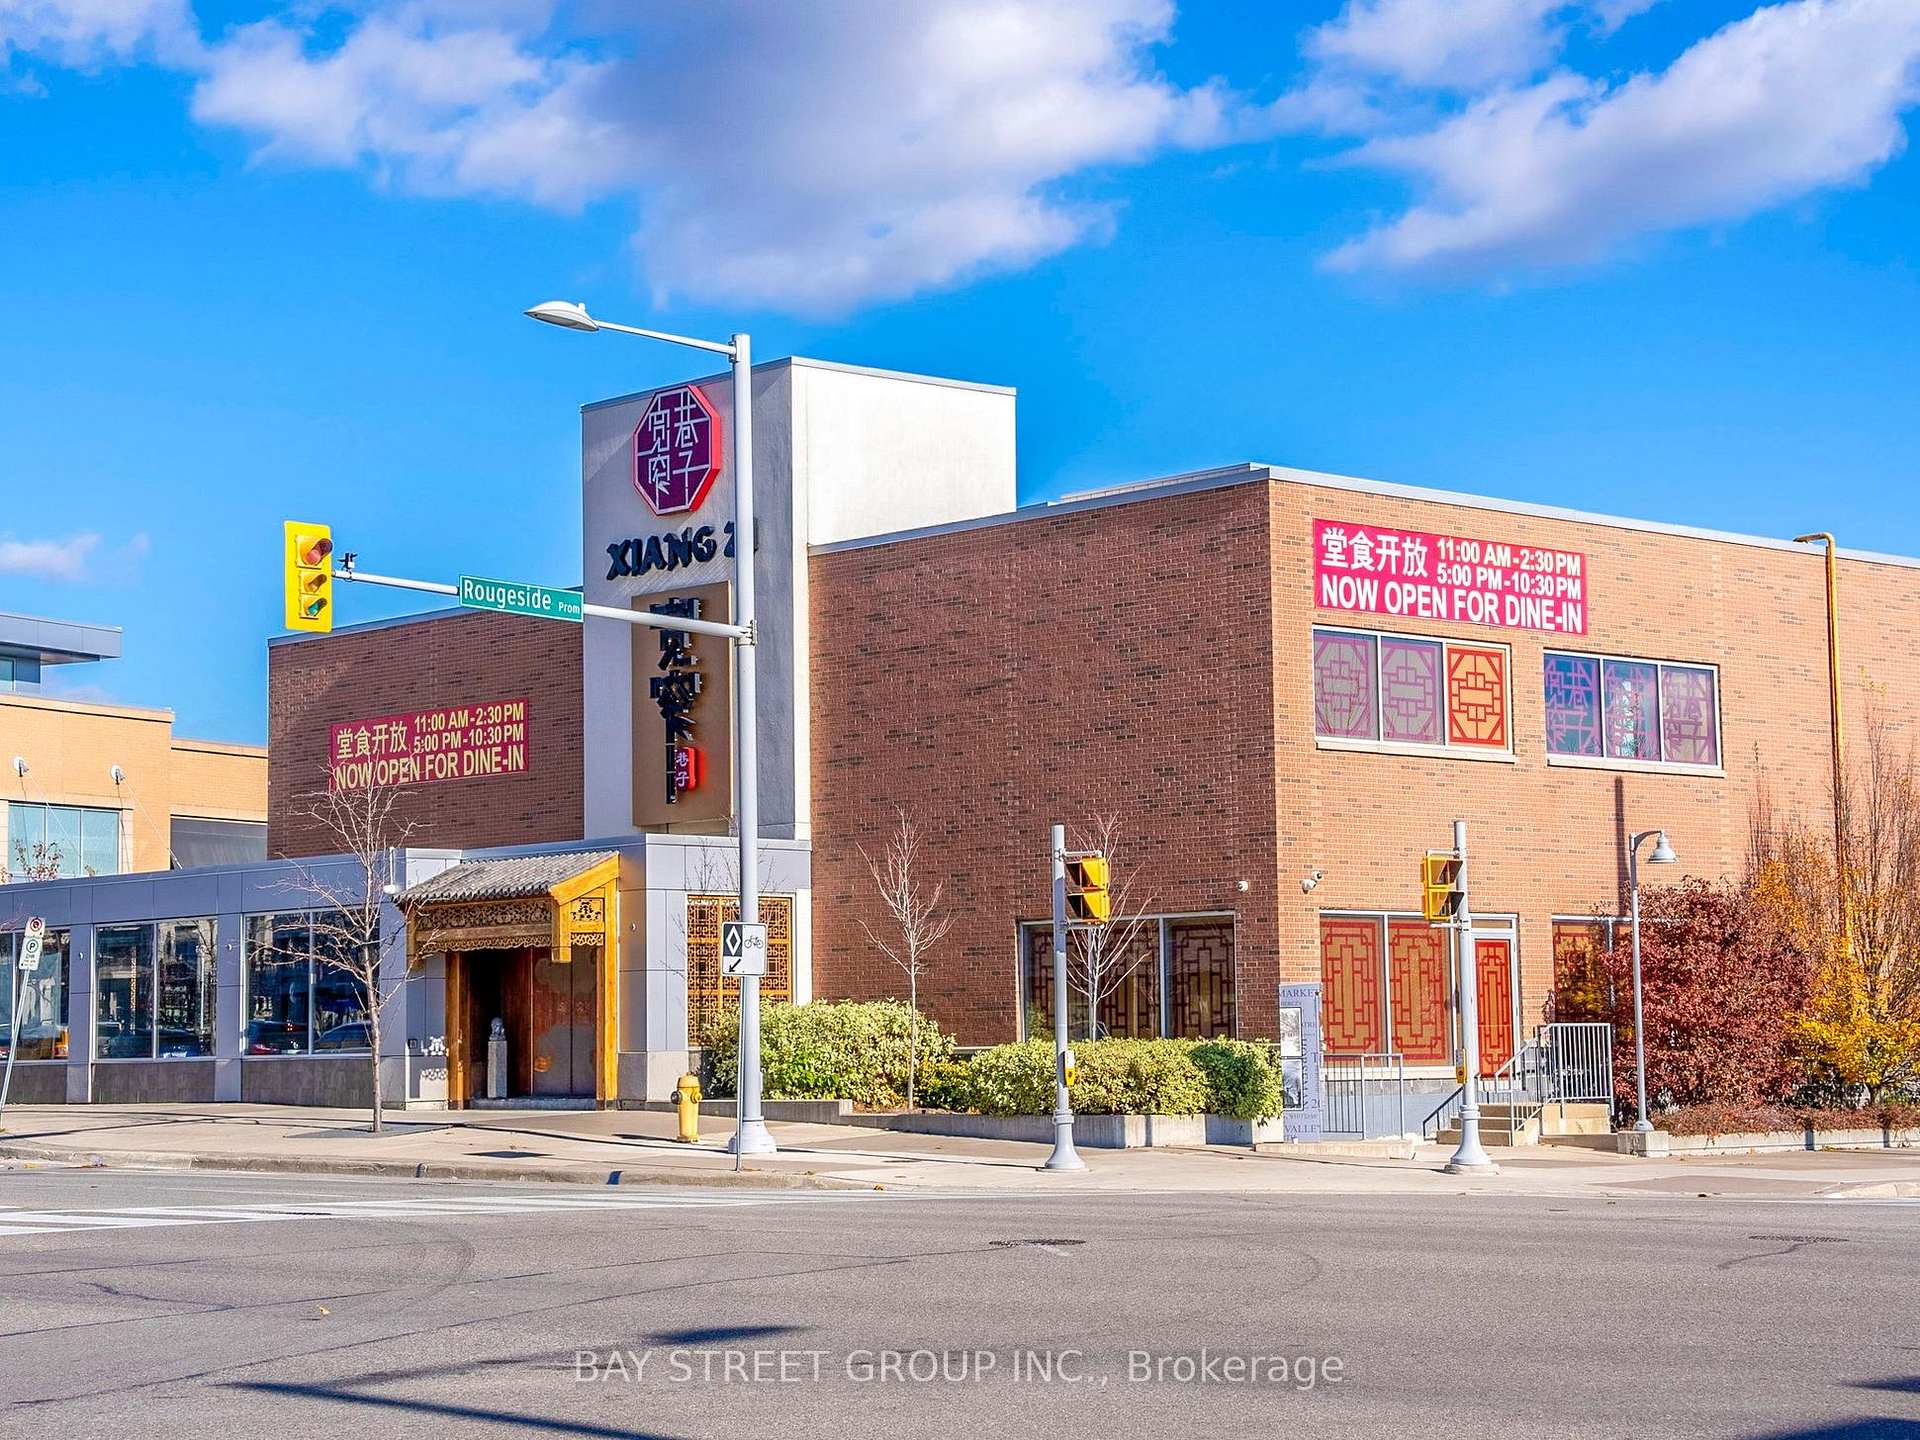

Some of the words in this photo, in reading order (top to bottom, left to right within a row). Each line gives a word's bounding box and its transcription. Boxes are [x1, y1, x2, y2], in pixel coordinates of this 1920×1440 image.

[606, 525, 717, 580] XIANG
[1322, 527, 1428, 578] 堂食开放
[1437, 538, 1480, 564] 11:00
[1556, 553, 1581, 577] PM
[464, 579, 551, 610] Rougeside
[558, 602, 580, 614] Prom
[1437, 562, 1472, 587] 5:00
[1556, 576, 1581, 600] PM
[1322, 573, 1379, 612] NOW
[1384, 581, 1448, 619] OPEN
[1453, 589, 1500, 625] FOR
[1505, 595, 1582, 634] DINE-IN
[414, 713, 445, 734] 11:00
[504, 702, 524, 722] PM
[336, 721, 408, 759] 堂食开放
[413, 734, 439, 753] 5:00
[504, 723, 524, 743] PM
[335, 761, 373, 790] NOW
[376, 756, 420, 785] OPEN
[425, 751, 459, 780] FOR
[463, 743, 524, 776] DINE-IN
[676, 751, 690, 787] 巷子
